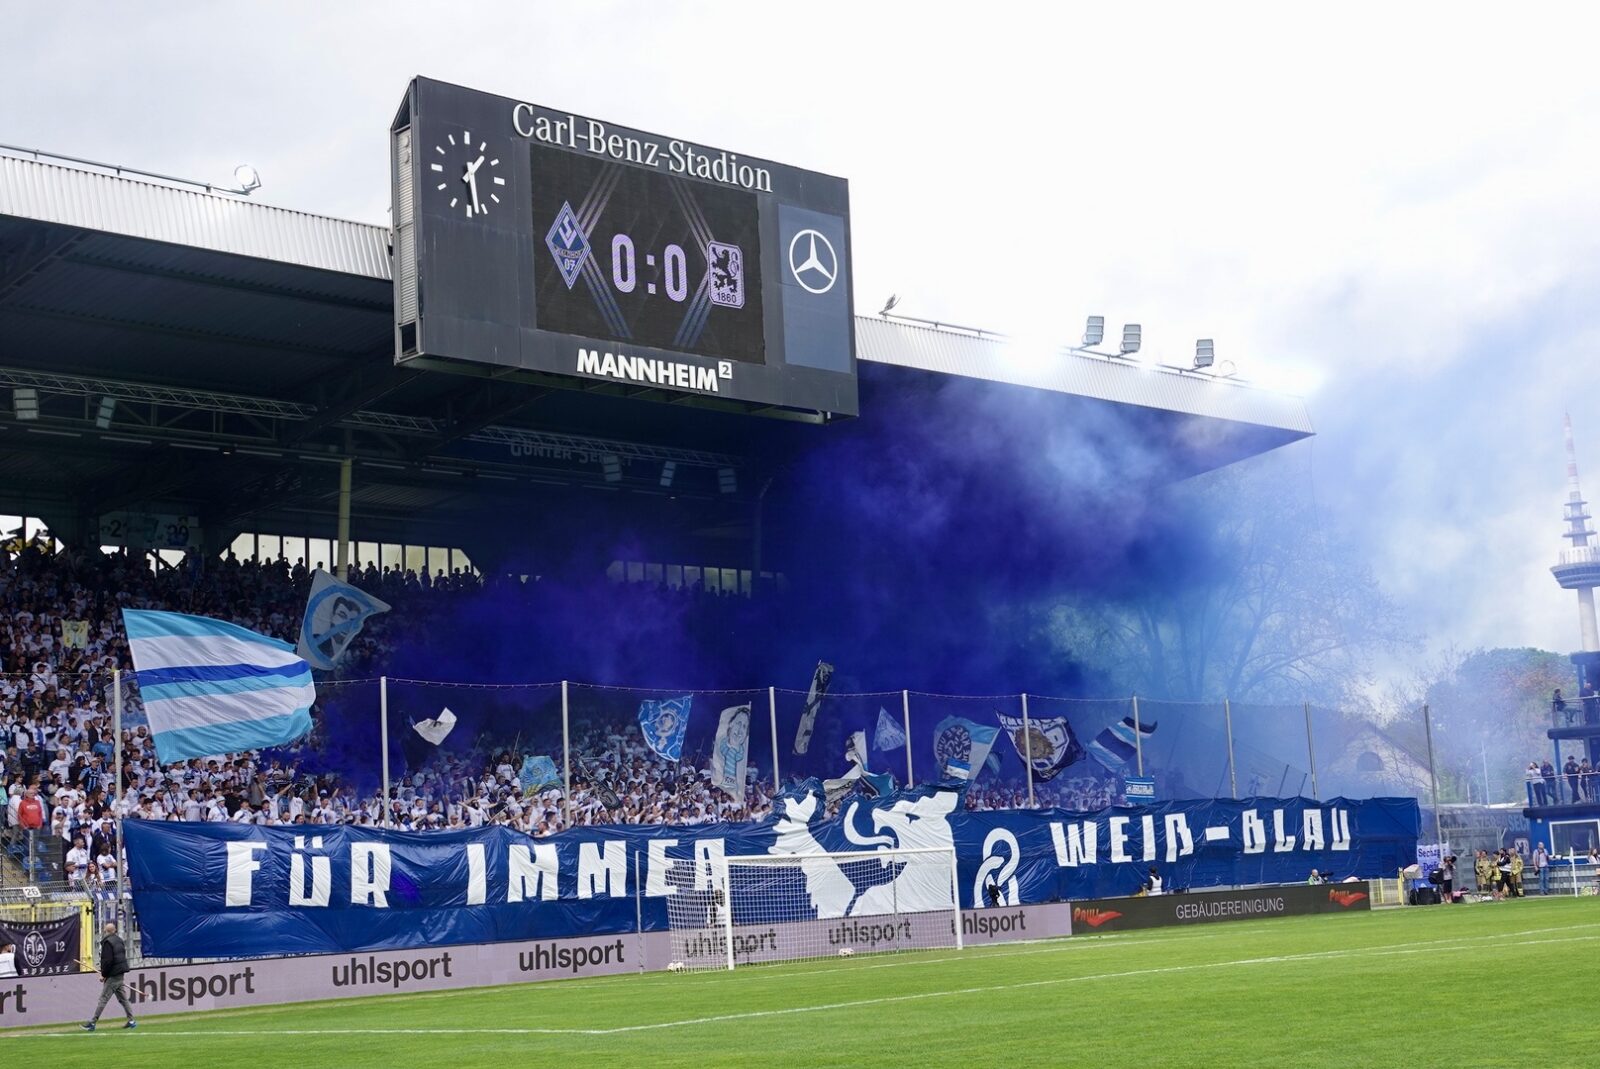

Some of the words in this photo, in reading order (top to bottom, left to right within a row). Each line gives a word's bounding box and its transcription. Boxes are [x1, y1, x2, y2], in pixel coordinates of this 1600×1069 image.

[513, 103, 773, 193] Carl-Benz-Stadion
[717, 292, 737, 304] 1860
[225, 835, 392, 908] FÜR
[467, 838, 726, 906] IMMER
[25, 888, 38, 897] 26
[1175, 896, 1285, 920] GEBÄUDEREINIGUNG
[55, 940, 66, 952] 12
[828, 919, 912, 946] uhlsport
[519, 939, 625, 972] uhlsport
[332, 952, 452, 988] uhlsport
